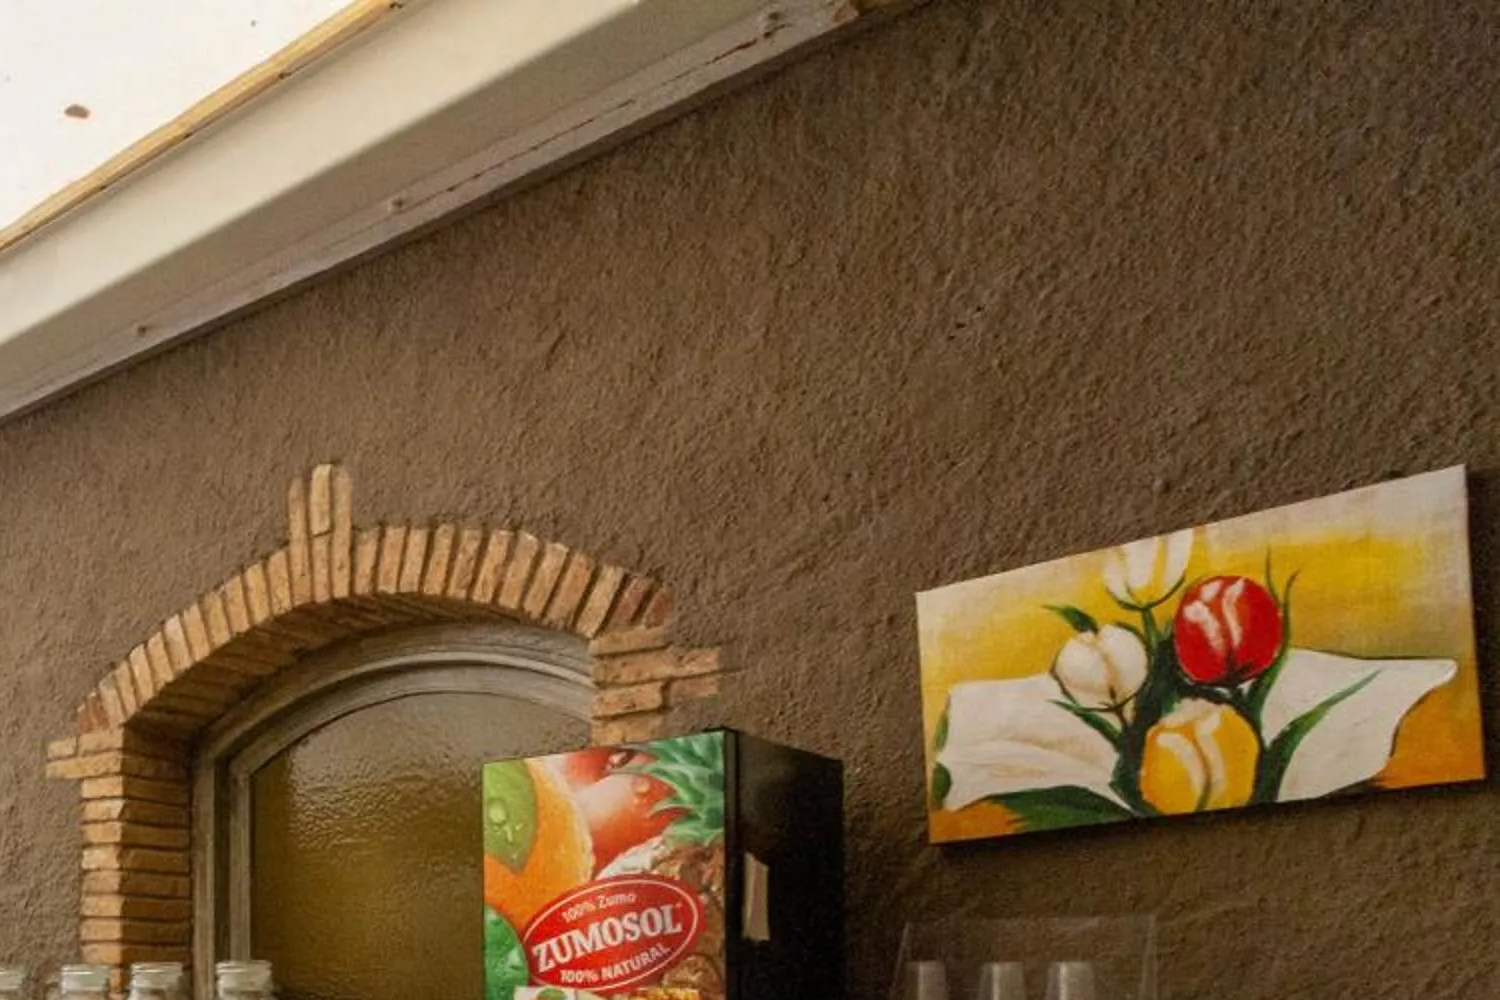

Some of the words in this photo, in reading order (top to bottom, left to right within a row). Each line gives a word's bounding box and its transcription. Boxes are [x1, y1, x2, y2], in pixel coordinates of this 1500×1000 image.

[562, 900, 596, 922] 100%
[597, 893, 637, 909] Zumo
[532, 904, 683, 973] ZUMOSOL
[560, 969, 599, 983] 100%
[601, 943, 670, 980] NATURAL
